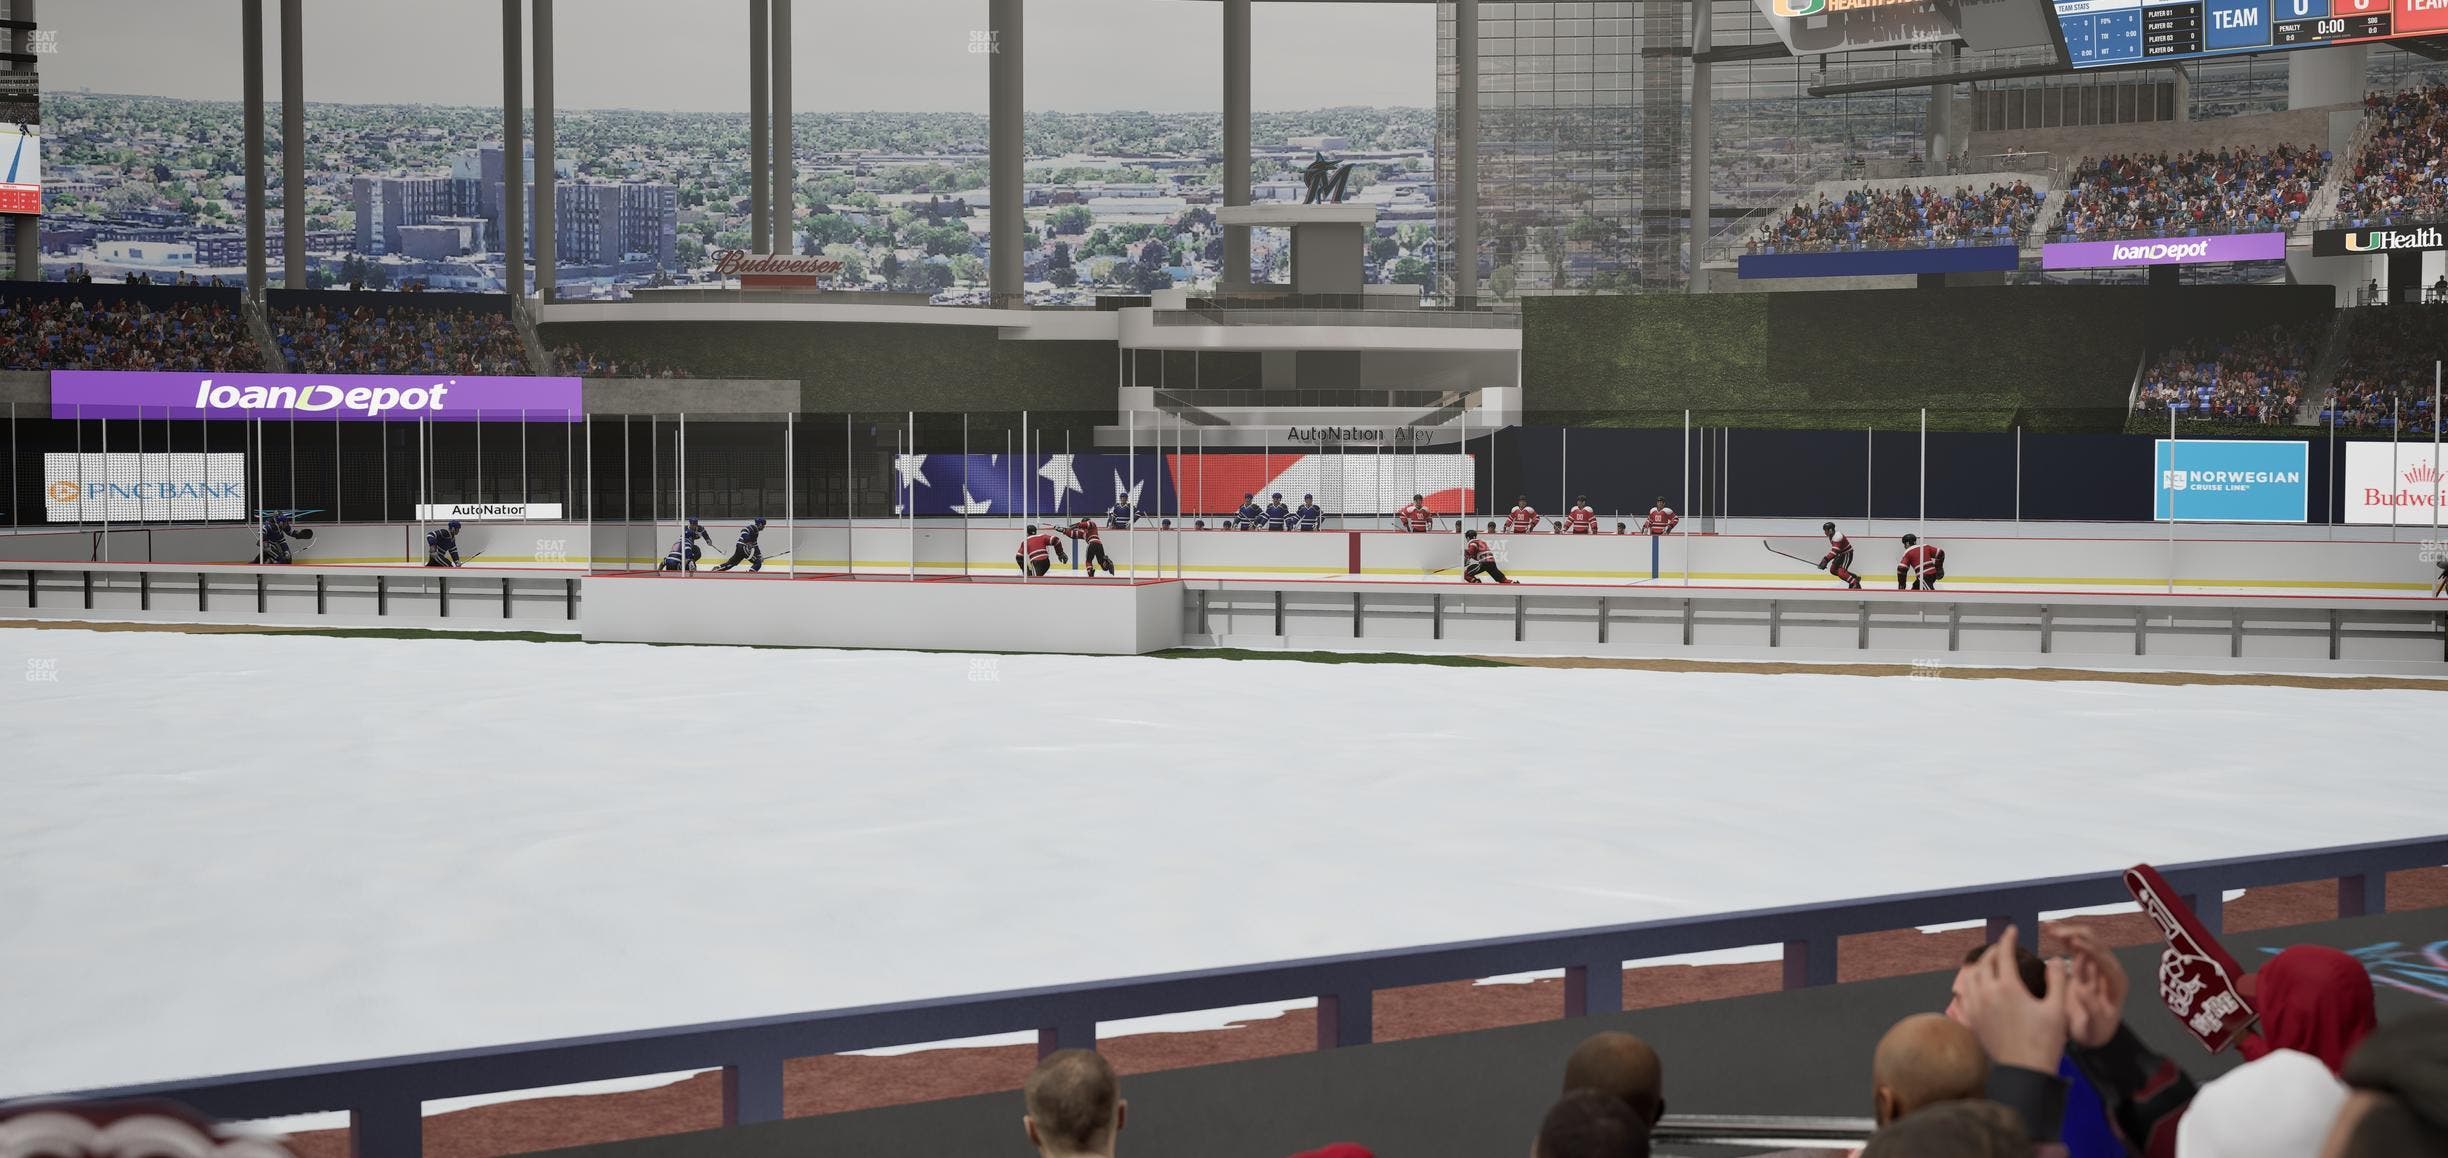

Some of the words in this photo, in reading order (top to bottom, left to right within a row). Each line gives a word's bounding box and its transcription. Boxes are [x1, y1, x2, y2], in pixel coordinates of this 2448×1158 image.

[2148, 10, 2165, 18] PLAYER
[2212, 7, 2258, 29] TEAM
[2279, 24, 2301, 33] PENALTY
[2318, 19, 2345, 34] 0:00
[2148, 35, 2166, 43] PLAYER
[2149, 46, 2166, 54] PLAYER
[2112, 239, 2208, 261] loanDepot
[711, 250, 845, 275] Budweiser
[195, 379, 448, 417] loanDepot
[1288, 426, 1384, 441] AutoNation
[2190, 471, 2299, 483] NORWEGIAN
[88, 482, 152, 500] PNC
[158, 482, 241, 500] BANK
